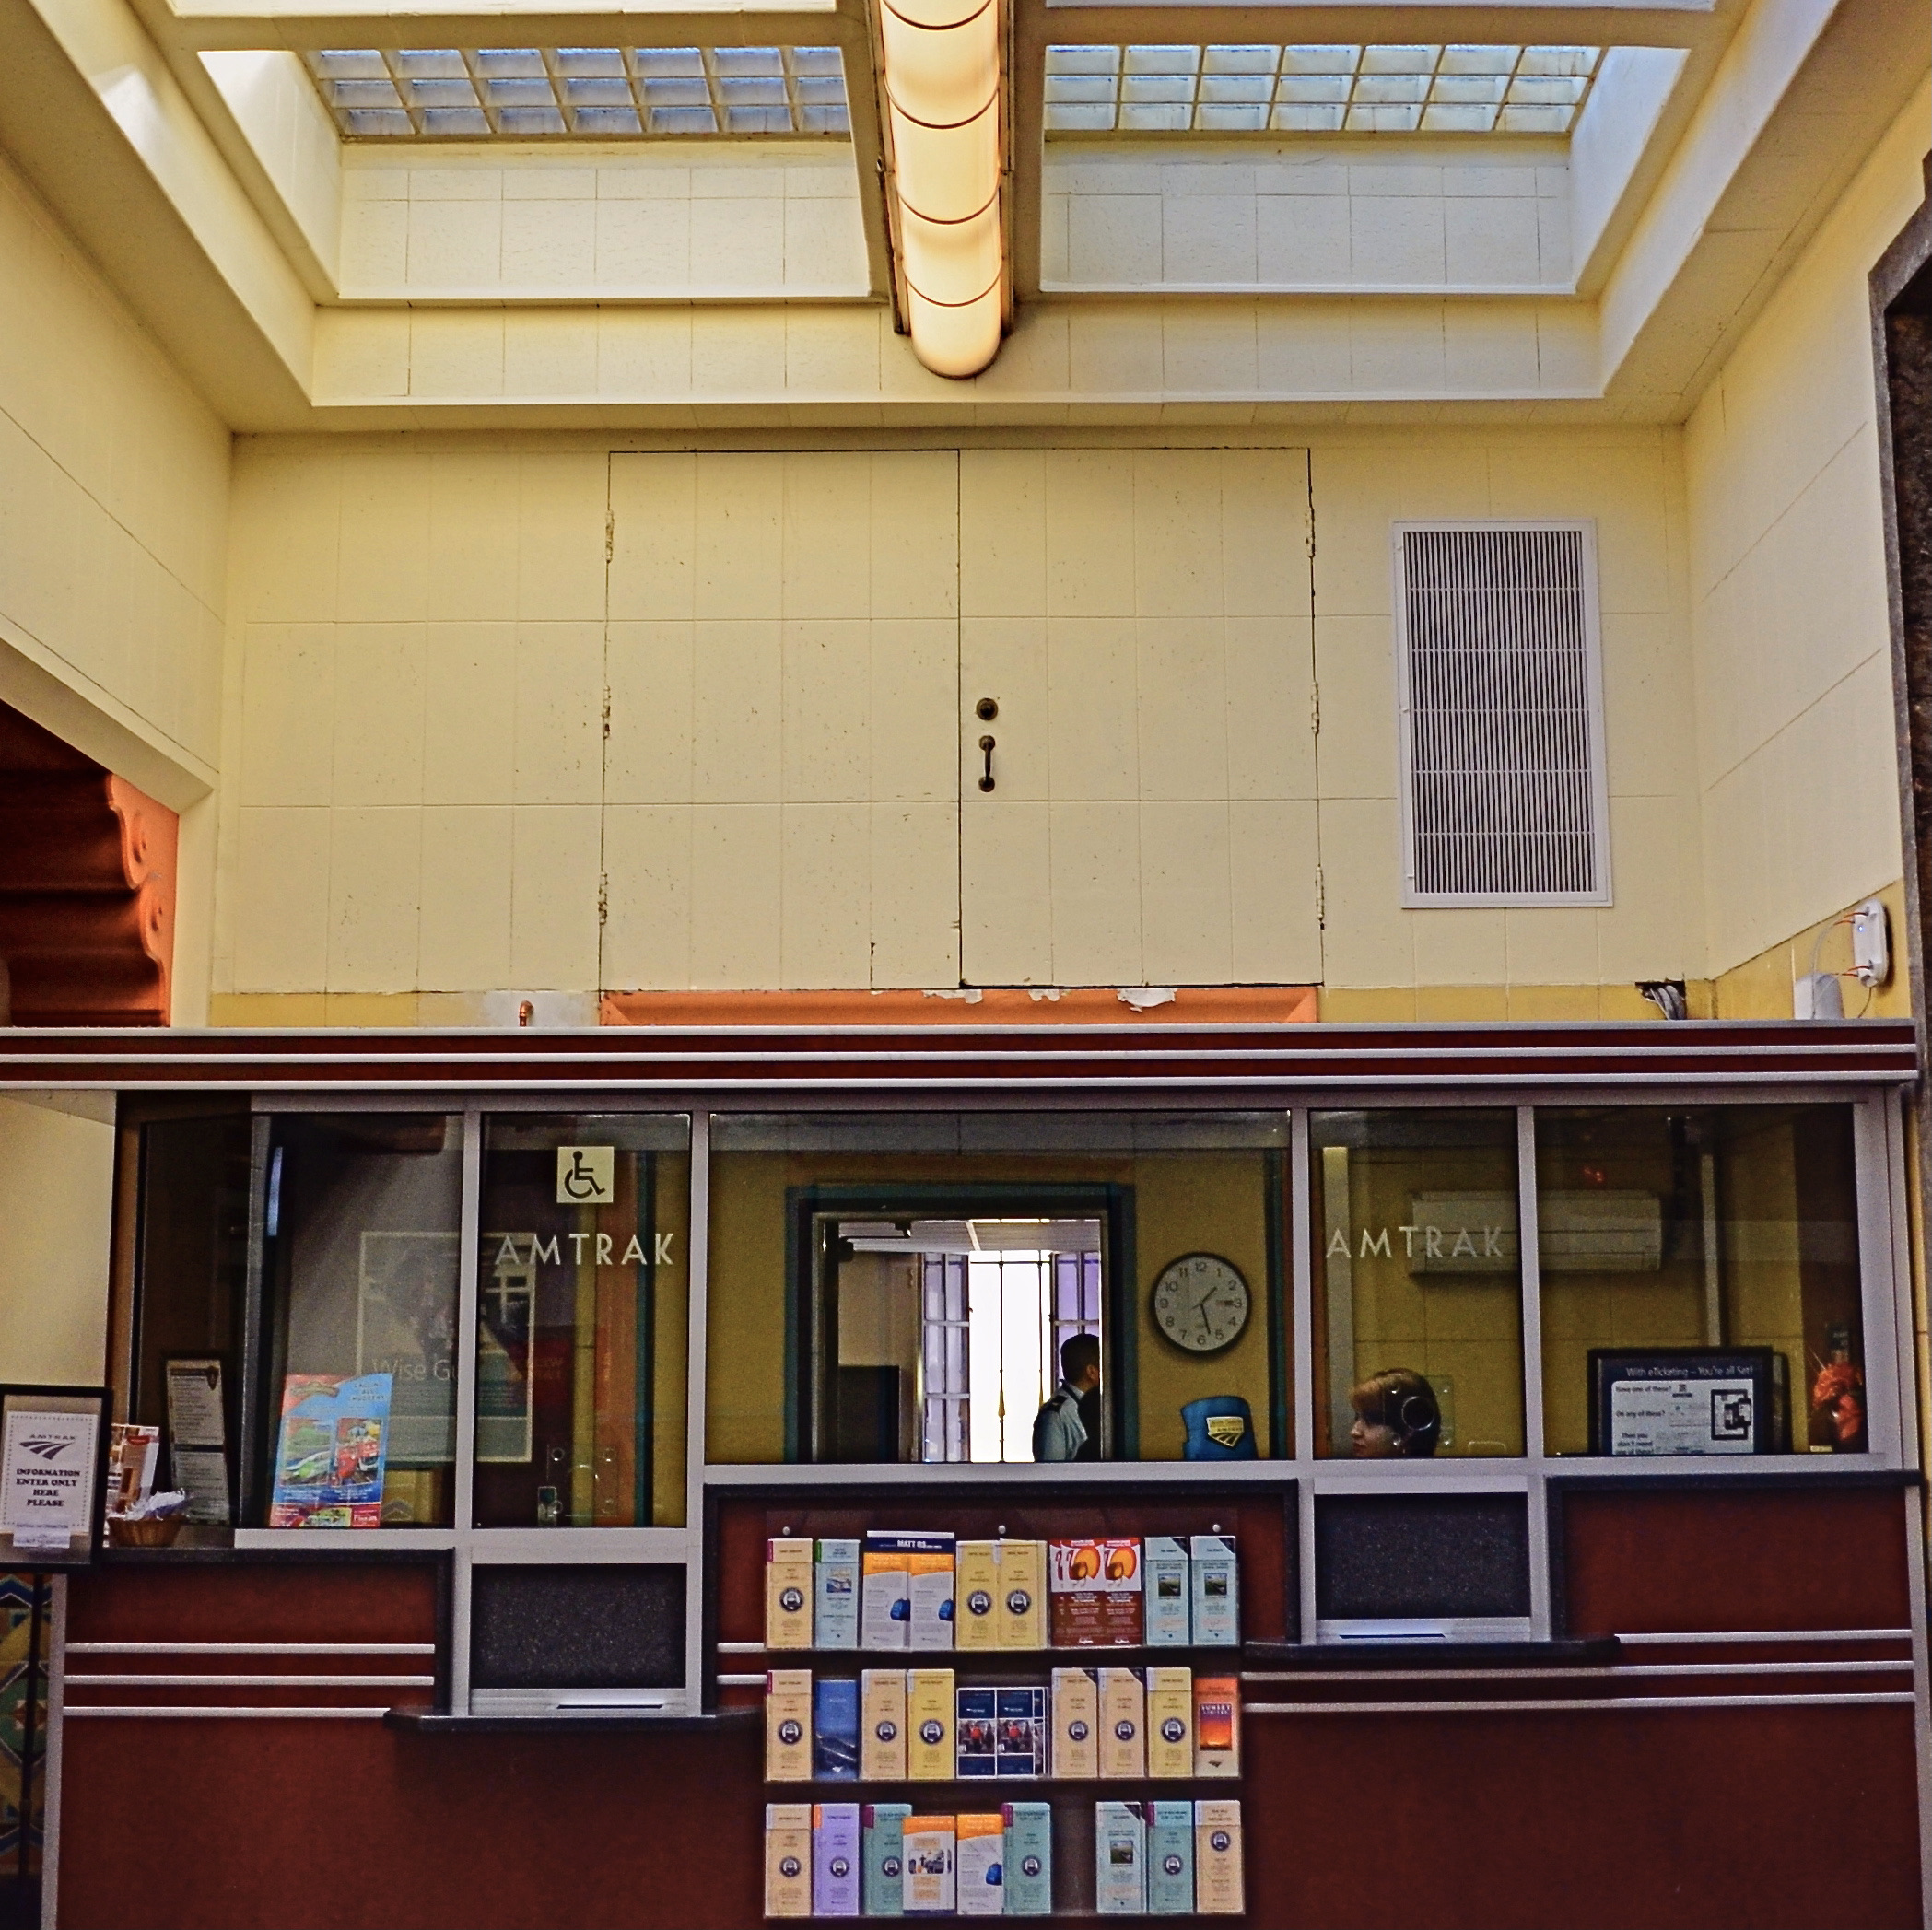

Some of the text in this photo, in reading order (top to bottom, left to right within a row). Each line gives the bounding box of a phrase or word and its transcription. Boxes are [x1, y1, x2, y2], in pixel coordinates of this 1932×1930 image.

[1326, 1226, 1503, 1258] AMTRAK
[494, 1233, 674, 1266] AMTRAK
[1195, 1262, 1207, 1272] 12
[1178, 1268, 1188, 1278] 11
[1165, 1281, 1178, 1293] 10
[1228, 1280, 1237, 1291] 2
[1160, 1298, 1168, 1308] 9
[1234, 1298, 1243, 1308] 3
[1165, 1316, 1175, 1328] 8
[1228, 1316, 1237, 1328] 4
[1179, 1329, 1188, 1340] 7
[1197, 1334, 1206, 1345] 6
[1215, 1329, 1224, 1340] 5
[1626, 1366, 1646, 1377] With
[1648, 1366, 1688, 1379] eTicketing
[16, 1468, 81, 1477] INFORMATION
[16, 1478, 78, 1487] ENTER ONLY
[32, 1489, 60, 1497] HERE
[27, 1499, 64, 1507] PLEASE
